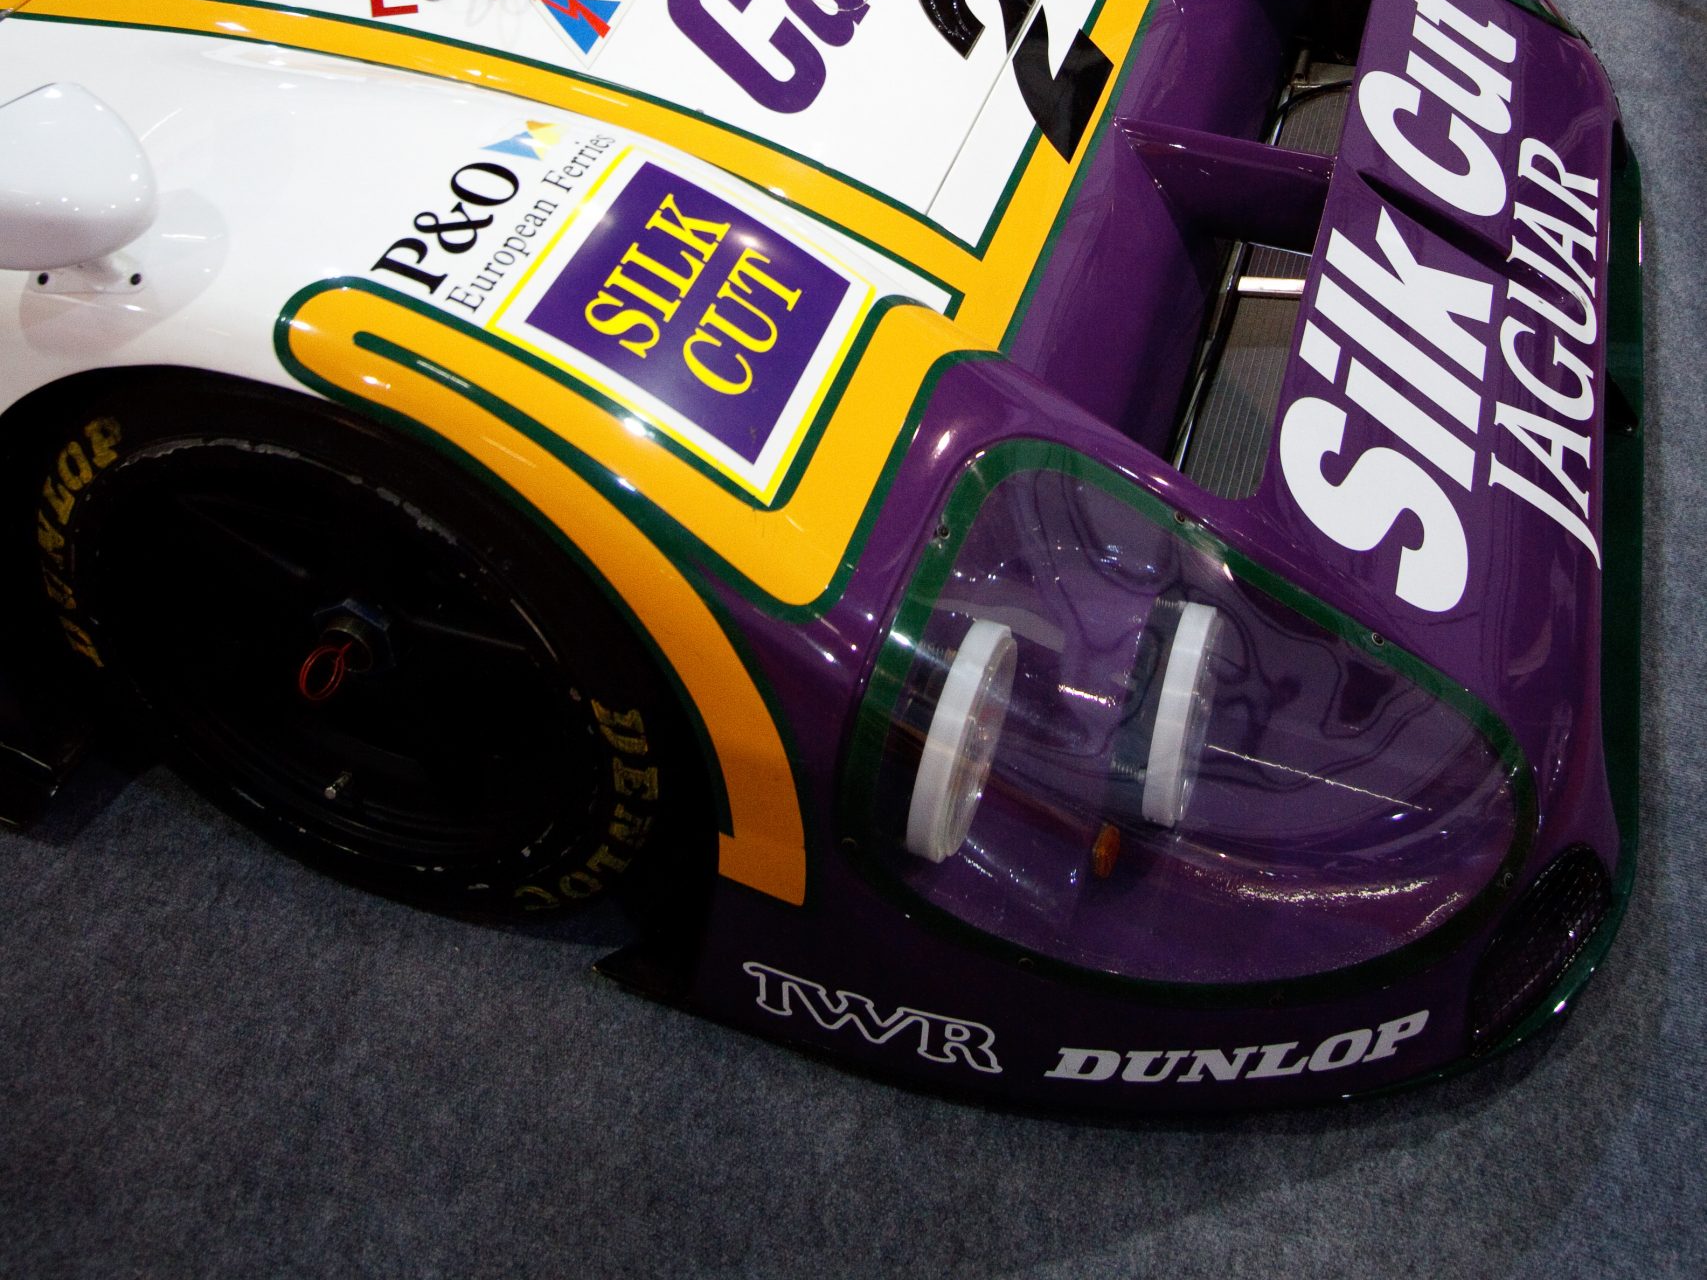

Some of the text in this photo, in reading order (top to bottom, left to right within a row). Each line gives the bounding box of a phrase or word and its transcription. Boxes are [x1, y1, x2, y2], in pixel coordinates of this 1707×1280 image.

[370, 162, 520, 295] P&O
[445, 133, 616, 314] European Ferries
[584, 193, 732, 359] SILK
[682, 247, 803, 396] CUT
[1488, 136, 1602, 570] JAGUAR
[1279, 205, 1495, 613] Silk
[743, 961, 1003, 1074] TWR
[1044, 1009, 1430, 1083] DUNLOP
